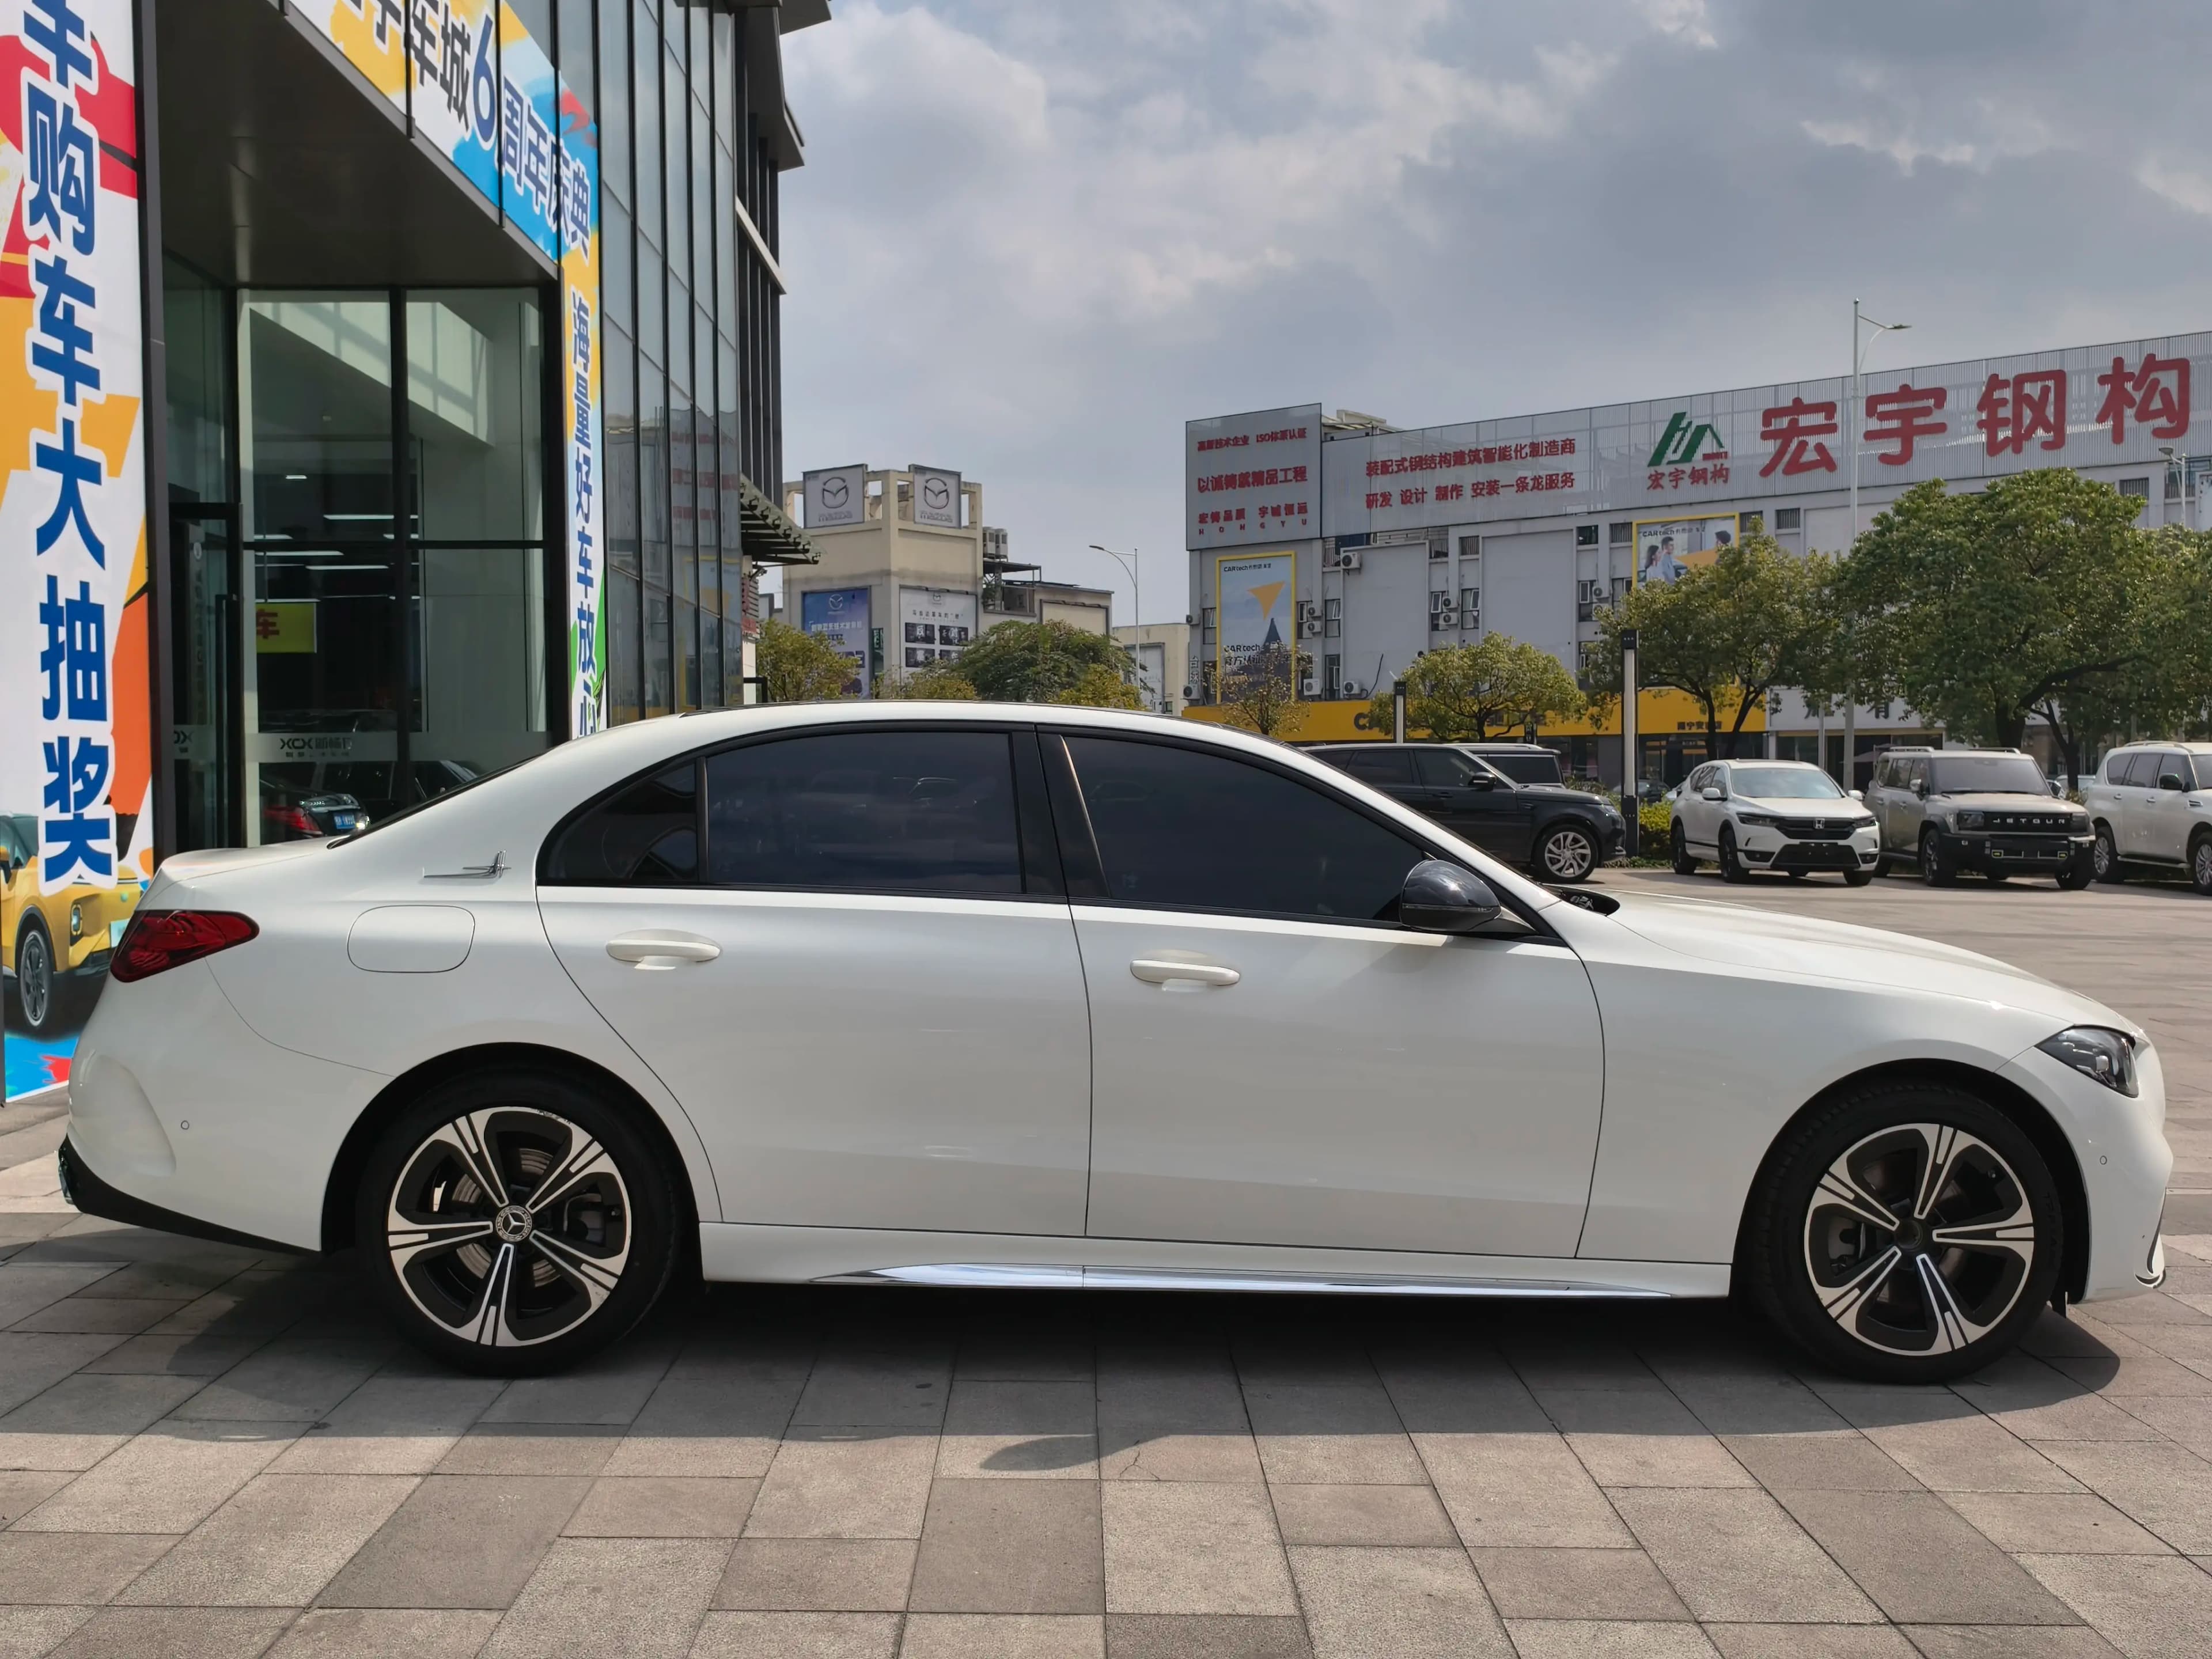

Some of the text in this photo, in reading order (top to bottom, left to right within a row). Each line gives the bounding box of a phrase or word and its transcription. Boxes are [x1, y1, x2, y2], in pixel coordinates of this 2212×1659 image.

[350, 0, 589, 259] 车城6周年庆典
[1760, 353, 2190, 477] 宏宇钢构
[1366, 438, 1575, 477] 装配式钢结构建筑智能化制造商
[1646, 463, 1730, 490] 宏宇钢构
[1366, 472, 1575, 509] 研发 设计 制作 安装一条龙服务
